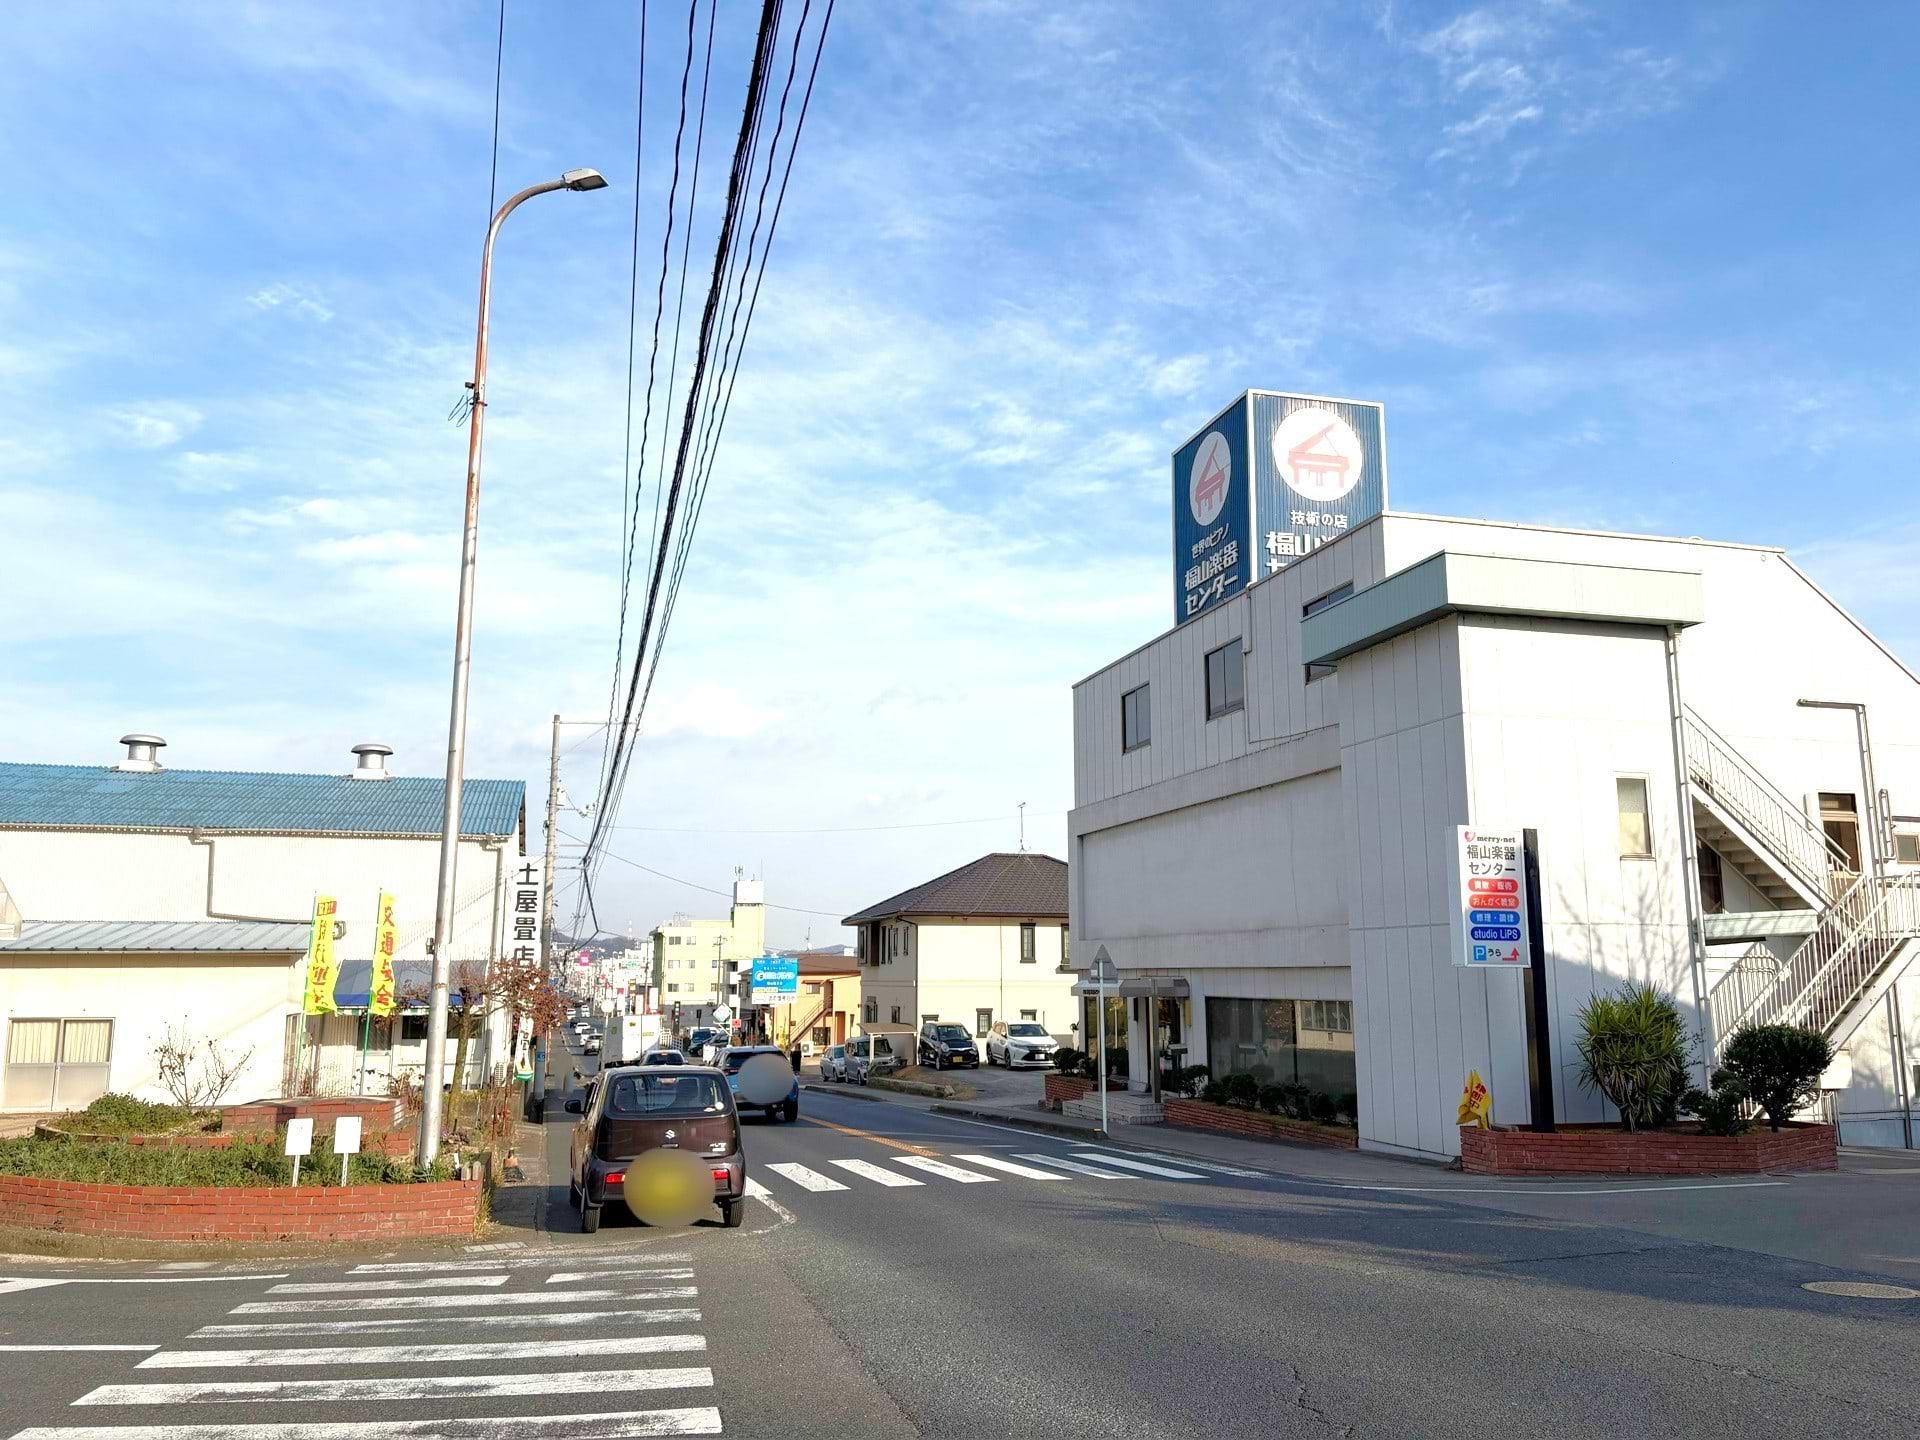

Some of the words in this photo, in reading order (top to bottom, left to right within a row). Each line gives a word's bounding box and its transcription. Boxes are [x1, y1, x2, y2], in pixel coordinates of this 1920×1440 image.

[1290, 510, 1348, 529] 技術の店
[1191, 523, 1230, 559] 世界のピアノ
[1184, 540, 1239, 592] 福山楽器
[1185, 573, 1239, 616] センター
[1467, 844, 1516, 861] 福山楽器
[1469, 862, 1516, 876] センター
[513, 862, 539, 968] 土屋畳店
[1474, 929, 1498, 940] studio
[1499, 929, 1518, 940] LiPS
[1487, 948, 1502, 958] うら
